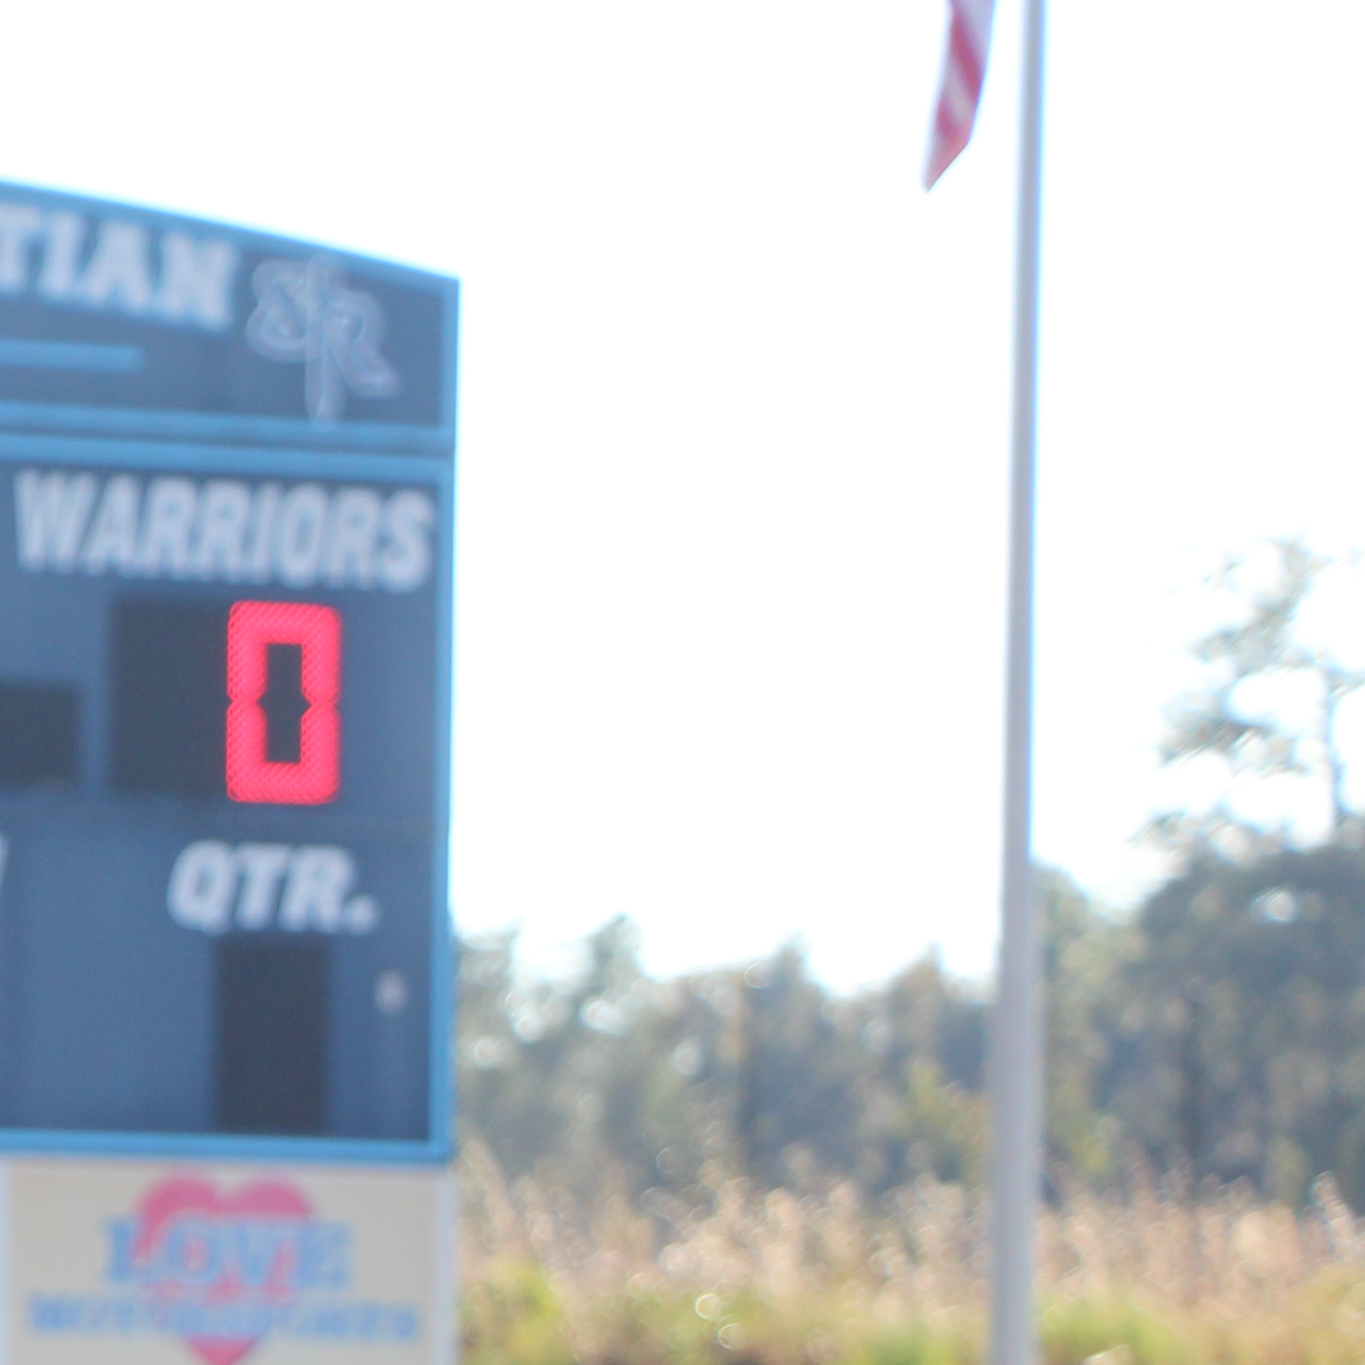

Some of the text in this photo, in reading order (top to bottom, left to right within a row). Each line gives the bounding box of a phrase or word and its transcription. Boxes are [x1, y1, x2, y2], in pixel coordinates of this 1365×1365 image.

[14, 468, 437, 594] WARRIORS
[225, 599, 342, 806] 0
[166, 838, 381, 936] QTR.
